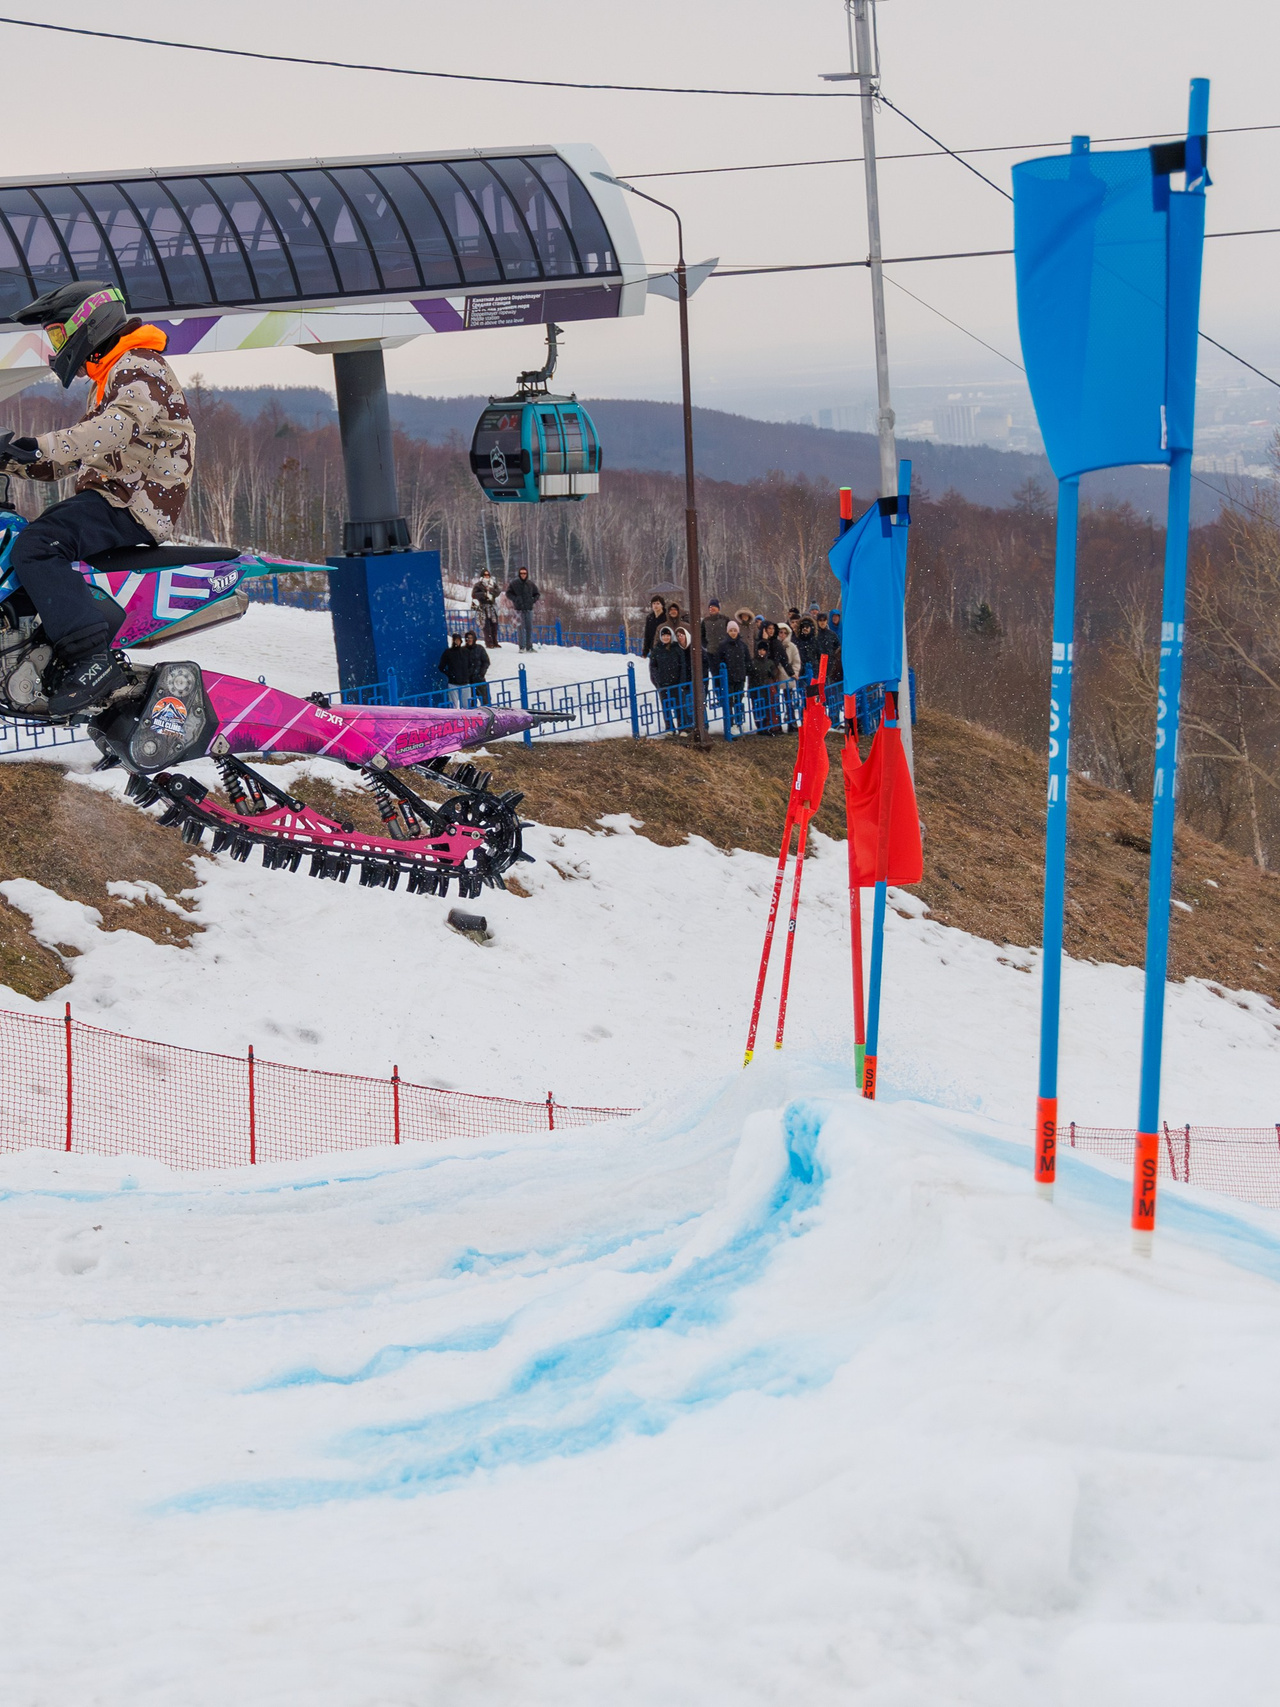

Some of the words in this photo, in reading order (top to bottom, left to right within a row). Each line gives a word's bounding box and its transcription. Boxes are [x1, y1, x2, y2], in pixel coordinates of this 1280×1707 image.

[79, 663, 102, 685] FXR
[320, 711, 343, 726] FXR
[863, 1068, 874, 1100] SPM
[1041, 1121, 1055, 1171] SPM
[1138, 1159, 1155, 1217] SPM
